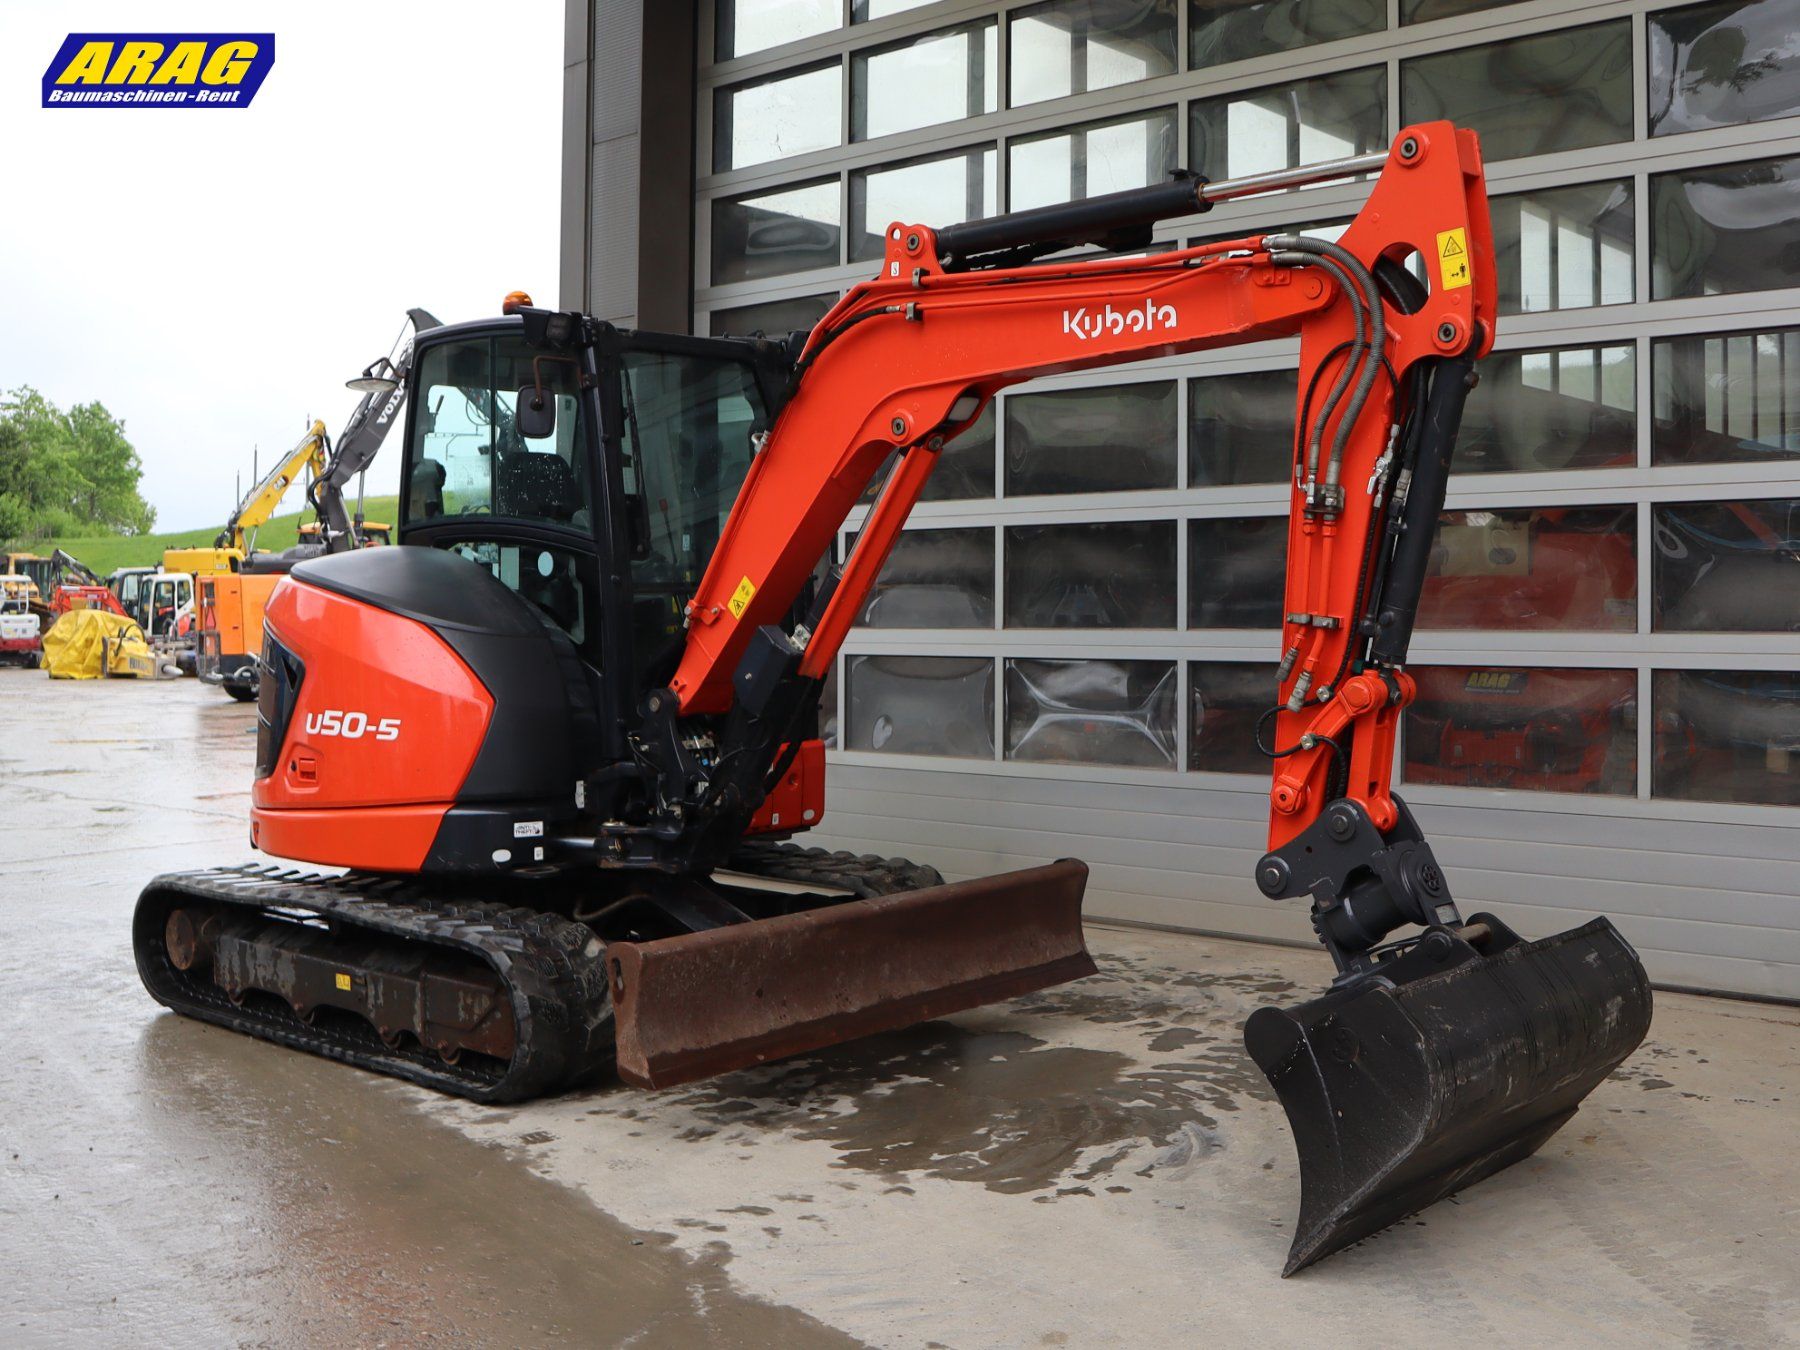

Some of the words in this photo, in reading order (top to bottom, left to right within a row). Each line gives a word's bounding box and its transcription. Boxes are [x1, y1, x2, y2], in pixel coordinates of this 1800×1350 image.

[1063, 298, 1177, 340] Kubota
[376, 378, 405, 424] VOLV
[1466, 671, 1511, 688] ARAG
[305, 709, 401, 741] U50-5
